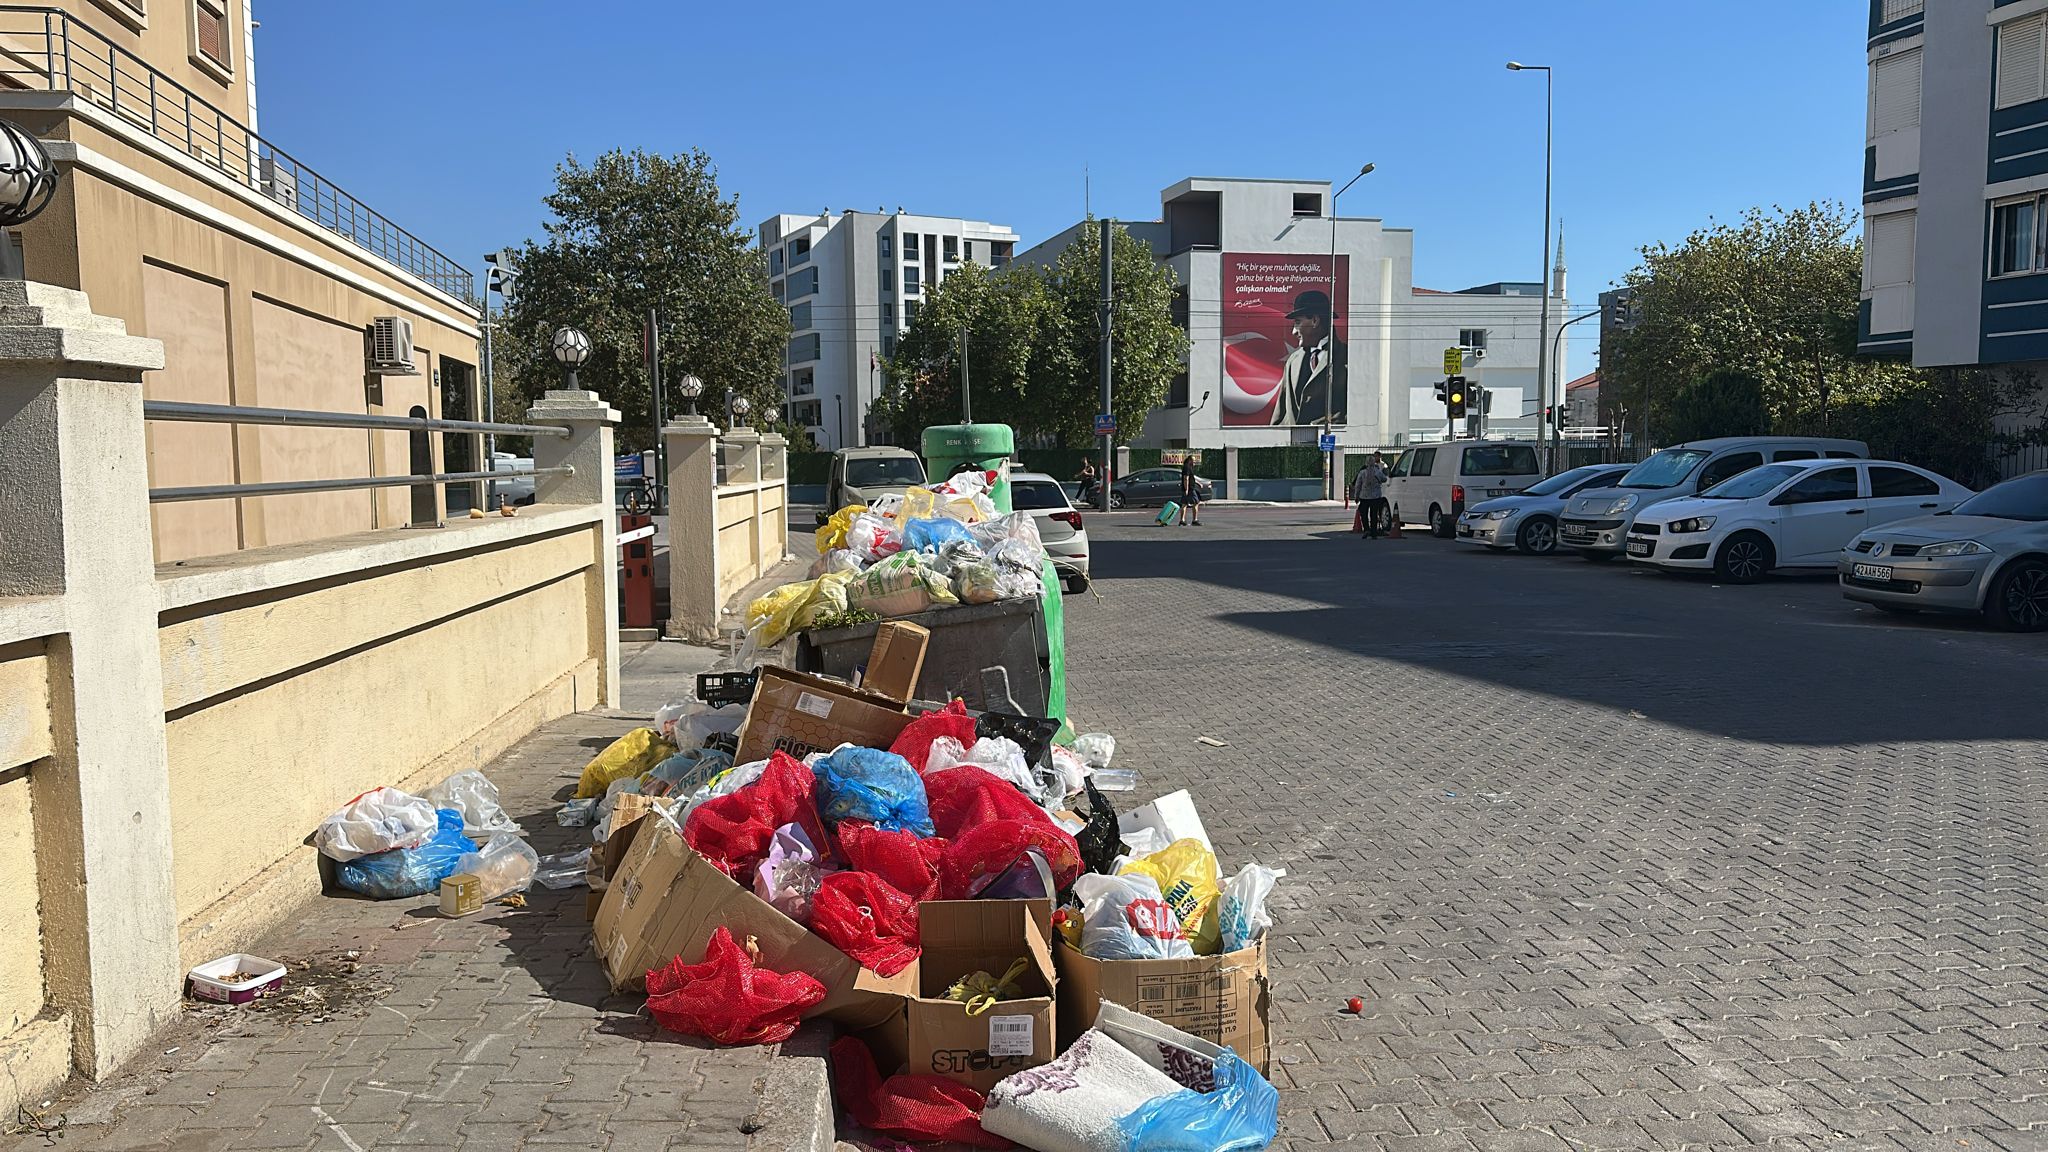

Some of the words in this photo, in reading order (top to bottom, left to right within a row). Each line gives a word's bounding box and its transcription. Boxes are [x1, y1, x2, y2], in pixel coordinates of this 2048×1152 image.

[1249, 263, 1259, 271] bir
[1259, 264, 1274, 273] şeye
[1273, 264, 1299, 273] muhtaç
[1275, 275, 1290, 283] şeye
[1289, 275, 1323, 283] ihtiyacımız
[1235, 284, 1264, 294] çalışkan
[1166, 879, 1194, 910] PINA
